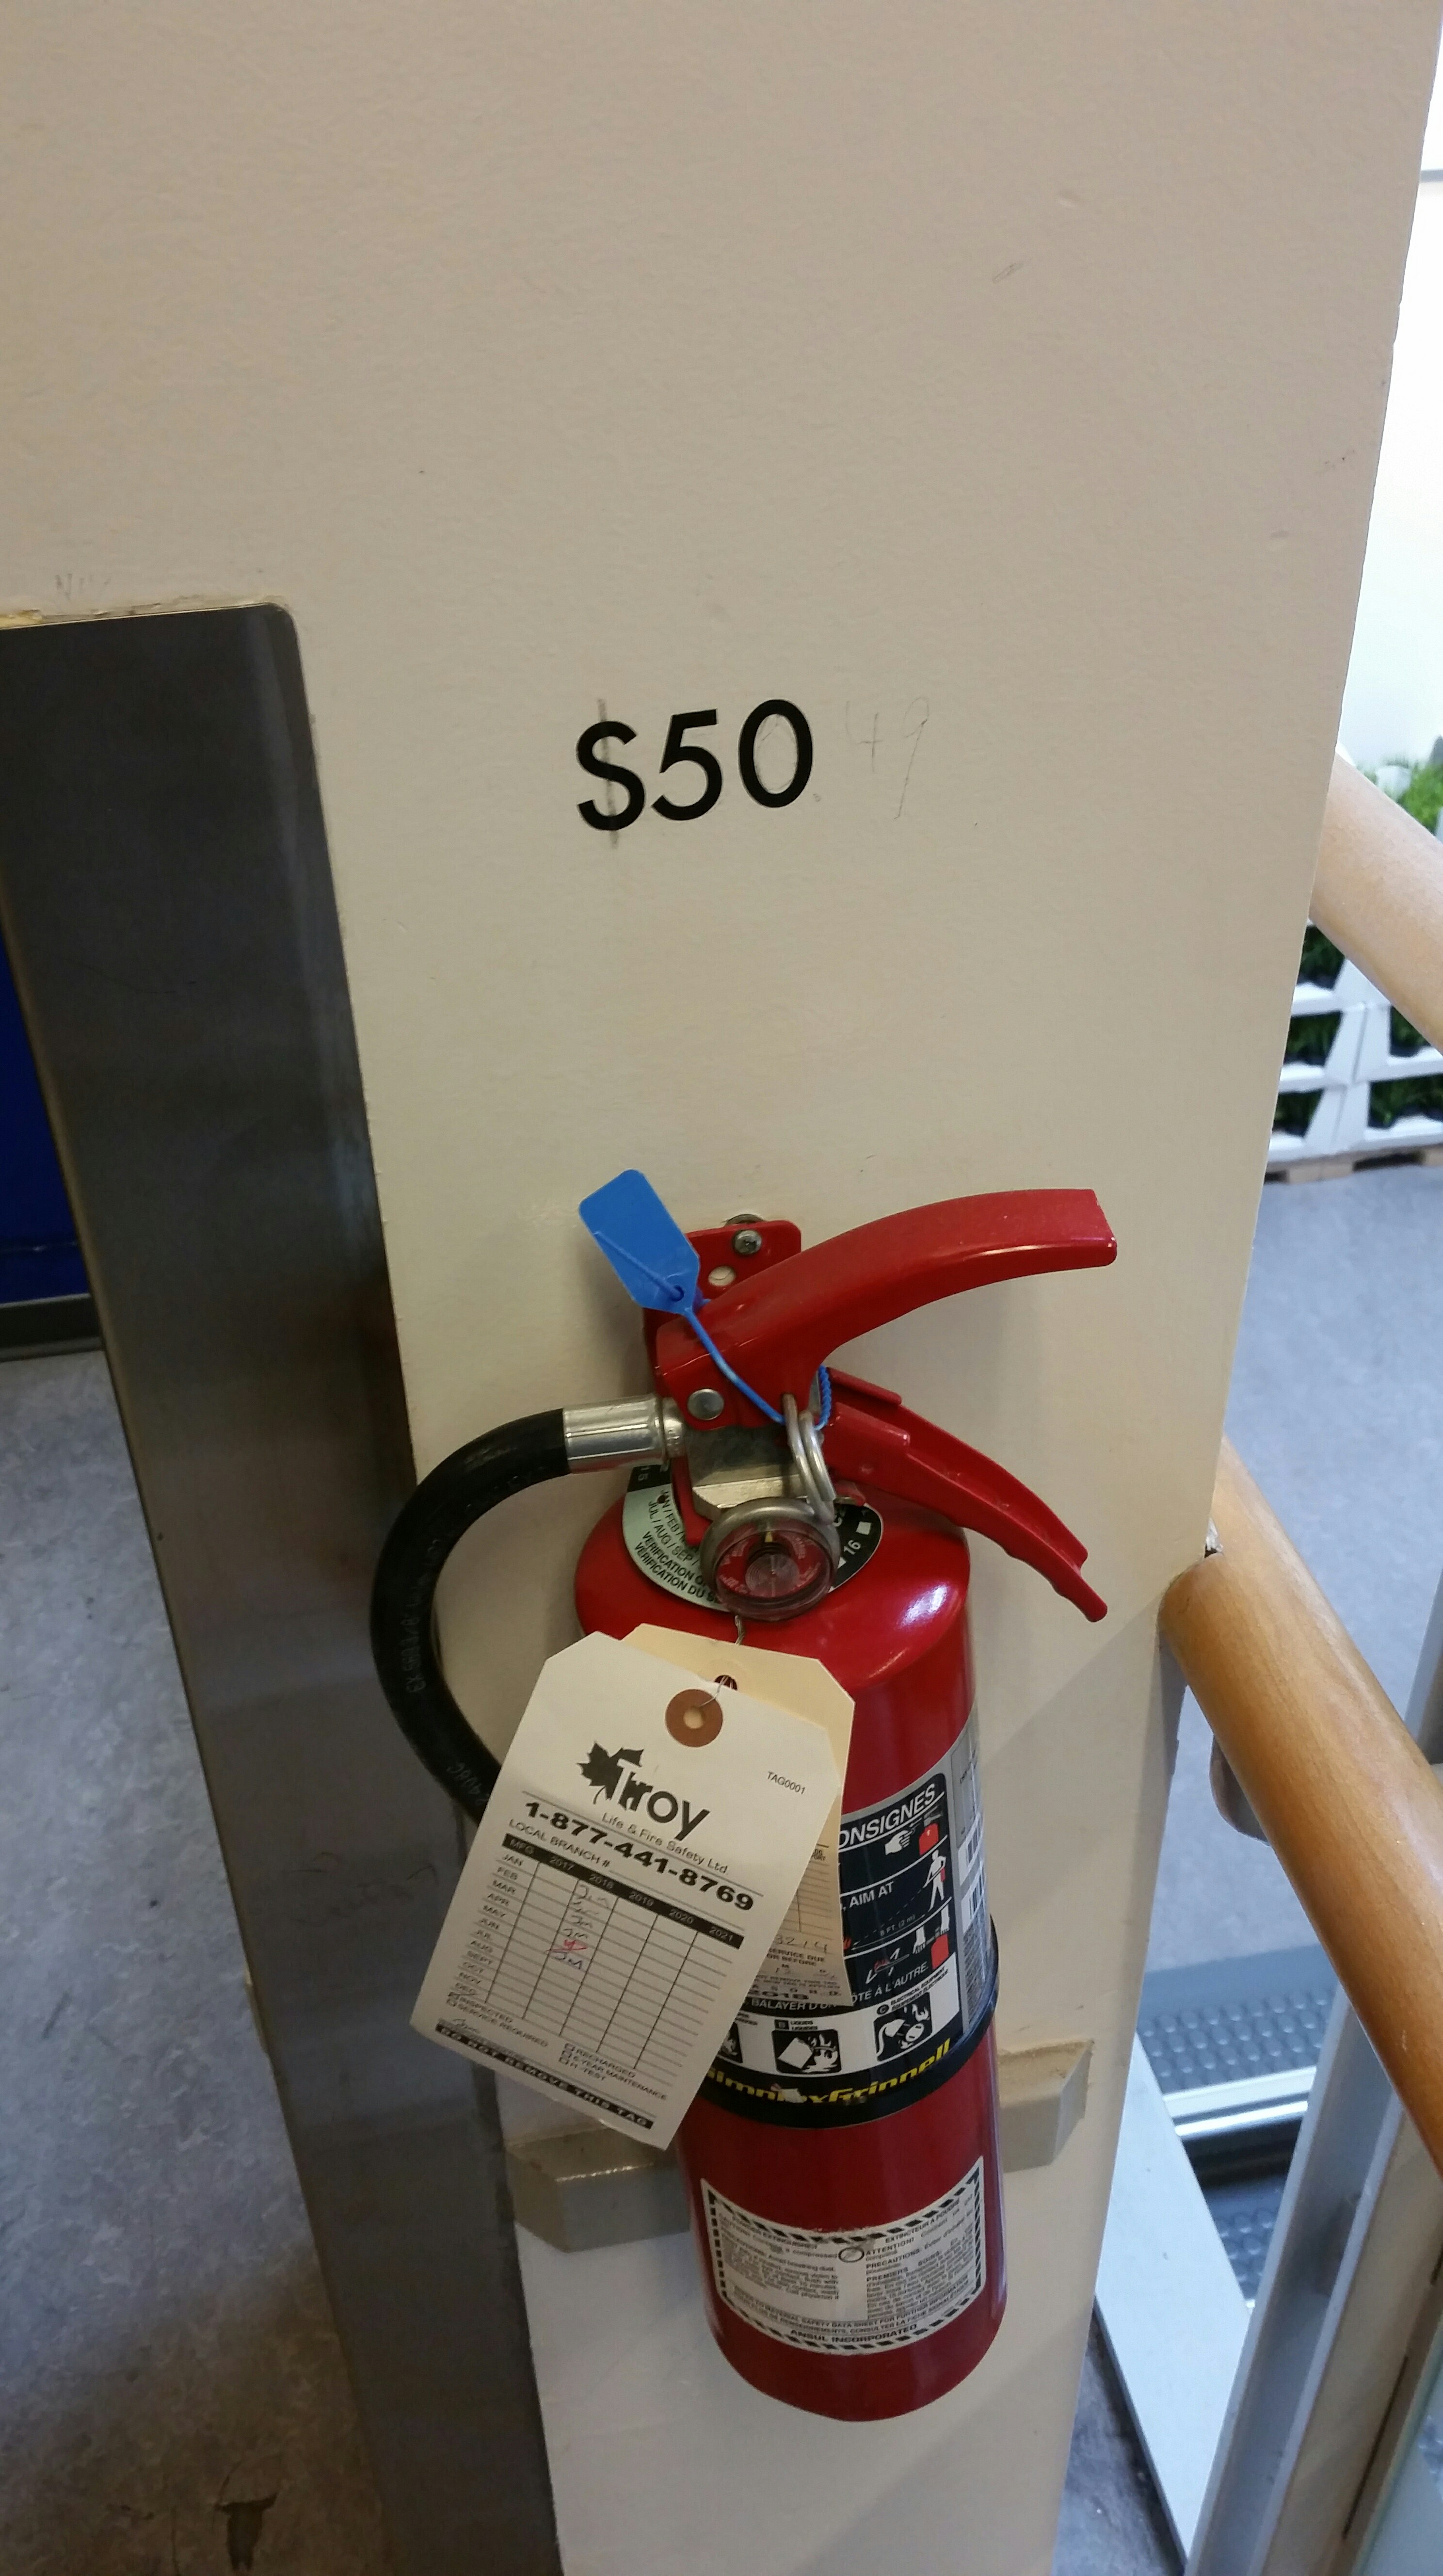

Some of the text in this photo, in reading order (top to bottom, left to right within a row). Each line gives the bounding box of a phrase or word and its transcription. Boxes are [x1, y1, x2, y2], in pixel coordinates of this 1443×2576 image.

[642, 1531, 694, 1581] VERIFICATION
[844, 1540, 862, 1555] 16
[688, 1585, 705, 1598] DU
[767, 1771, 806, 1795] TAG0001
[617, 1757, 711, 1841] Troy
[509, 1819, 547, 1841] LOCAL
[550, 1835, 601, 1864] BRANCH
[602, 1812, 624, 1829] Life
[627, 1823, 638, 1835] &
[639, 1828, 663, 1846] Fire
[666, 1840, 705, 1866] Safety
[502, 1854, 524, 1867] JAN
[525, 1801, 754, 1911] 1-877-441-8769
[497, 1867, 519, 1881] FEB
[492, 1879, 516, 1895] MAR
[849, 1889, 875, 1908] AIM
[878, 1881, 895, 1898] AT
[487, 1893, 510, 1907] APR
[549, 1856, 576, 1871] 2017
[629, 1891, 655, 1907] 2019
[669, 1909, 695, 1925] 2020
[708, 1926, 734, 1942] 2021
[483, 1905, 506, 1918] MAY
[751, 1998, 805, 2011] BALAYER
[831, 2323, 917, 2343] INCORPORATED
